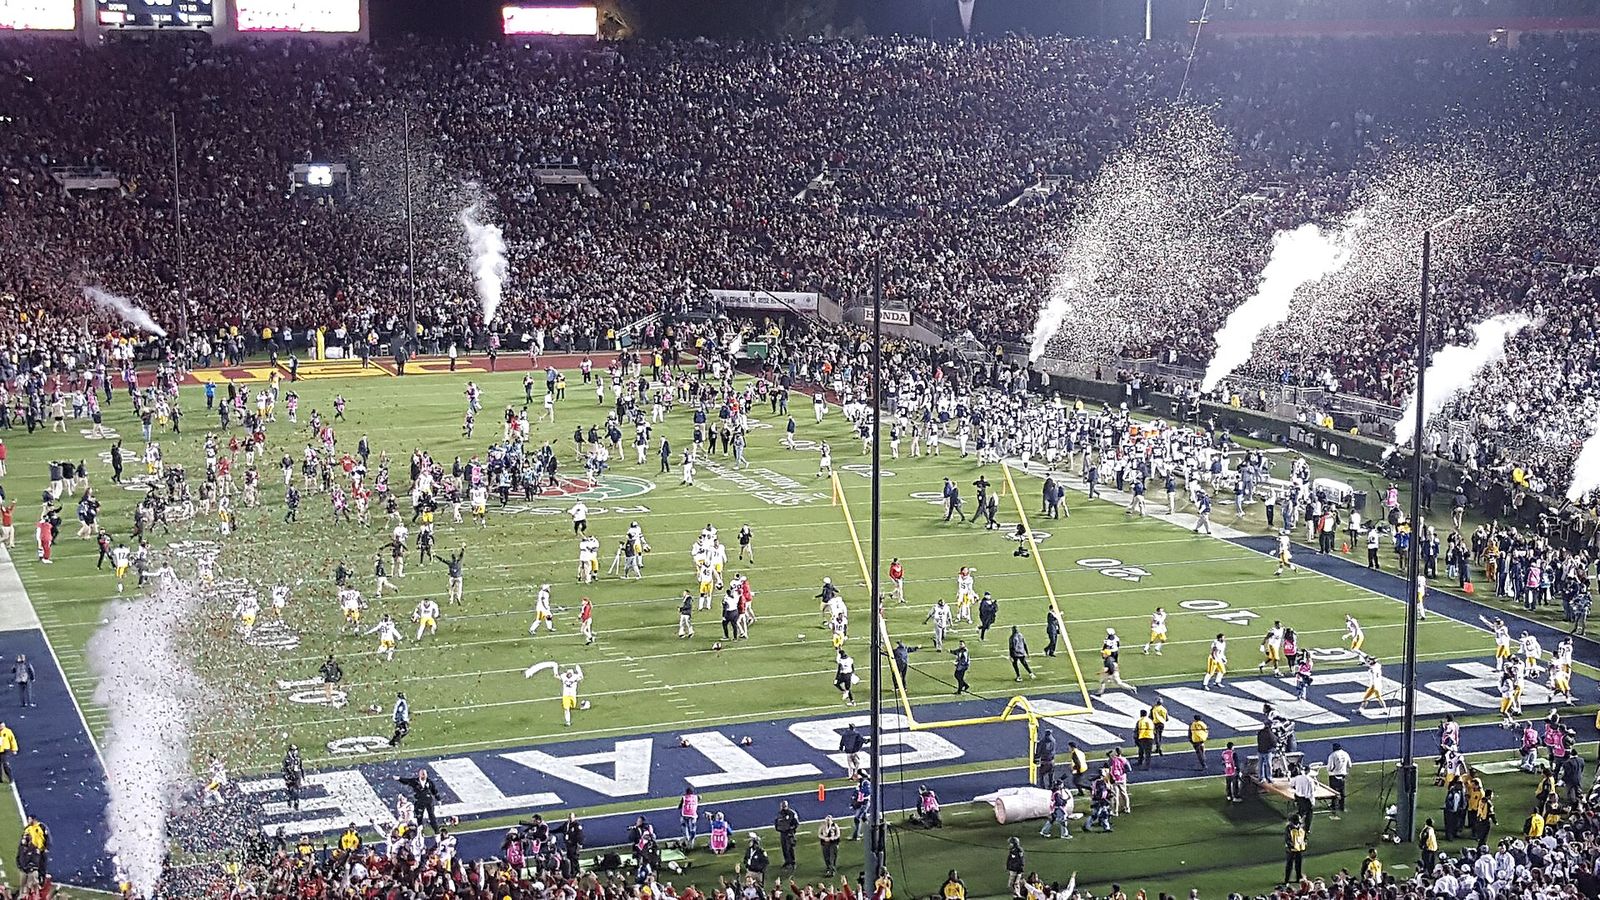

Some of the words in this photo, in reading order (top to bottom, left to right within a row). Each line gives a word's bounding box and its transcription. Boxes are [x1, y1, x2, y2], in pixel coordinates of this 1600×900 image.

[866, 310, 908, 322] HNDA
[1075, 557, 1152, 582] 20
[1178, 599, 1260, 626] 10
[1028, 661, 1580, 745] PENN
[238, 712, 965, 838] STATE
